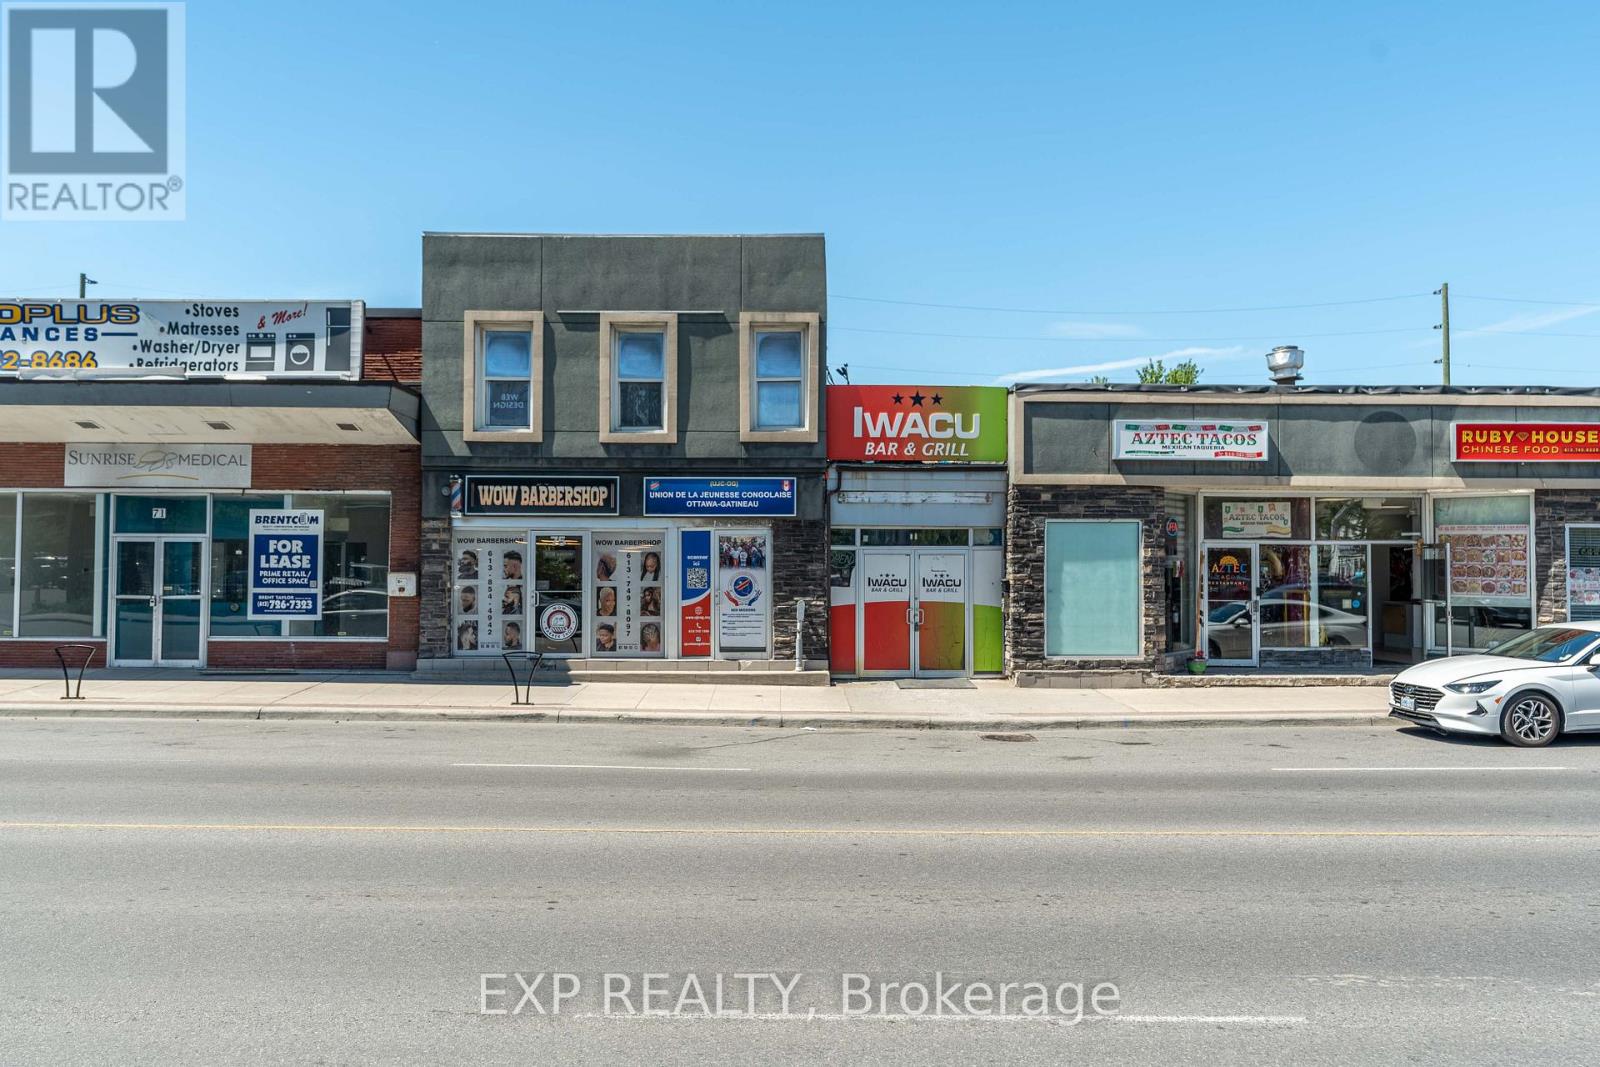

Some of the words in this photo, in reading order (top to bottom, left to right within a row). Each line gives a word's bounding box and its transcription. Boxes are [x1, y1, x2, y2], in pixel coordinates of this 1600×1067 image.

[192, 303, 240, 317] Stoves
[271, 303, 309, 325] More!
[0, 327, 98, 342] ANCES
[166, 321, 240, 335] Matresses
[140, 339, 240, 356] Washer/Dryer
[0, 350, 98, 369] 2-8686
[853, 406, 981, 439] IWACU
[1131, 432, 1193, 445] AZTEC
[1196, 433, 1257, 446] TACOS
[1462, 430, 1515, 443] RUBY
[1531, 430, 1599, 443] HOUSE
[865, 441, 898, 455] BAR
[904, 442, 916, 455] &
[922, 442, 969, 456] GRILL
[1524, 446, 1559, 454] FOOD
[68, 450, 136, 465] SUNRISE
[178, 454, 247, 466] MEDICAL
[478, 485, 518, 506] WOW
[520, 486, 608, 507] BARBERSHOP
[153, 508, 166, 518] 71
[1229, 513, 1257, 521] AZTEC
[1258, 513, 1285, 521] TACOS
[269, 540, 303, 553] FOR
[260, 555, 312, 568] LEASE
[1211, 563, 1247, 573] AZTEC
[867, 577, 907, 587] IWACU
[922, 577, 961, 587] IWACU
